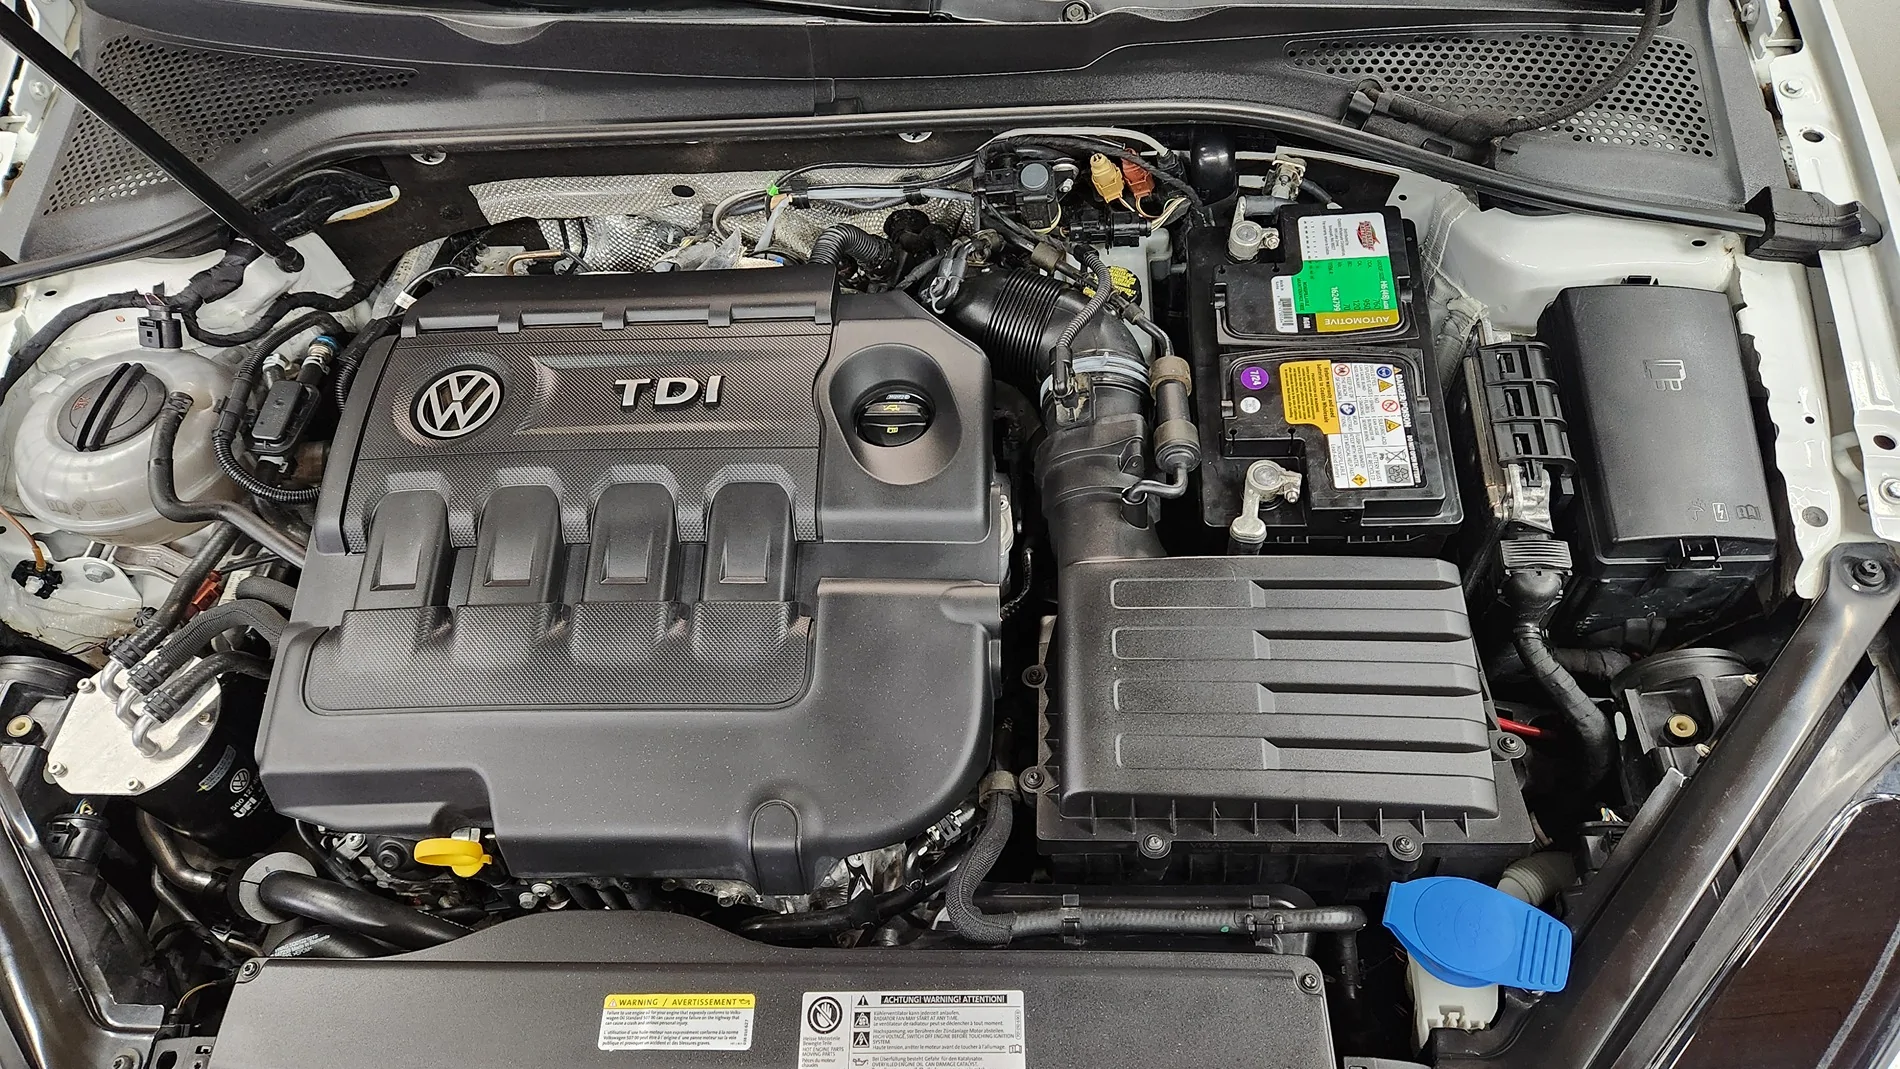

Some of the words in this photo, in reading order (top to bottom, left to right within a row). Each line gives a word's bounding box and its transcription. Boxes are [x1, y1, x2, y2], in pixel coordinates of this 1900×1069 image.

[1330, 286, 1341, 311] 1624799
[1302, 317, 1311, 329] AGM
[1324, 316, 1390, 326] AUTOMOTIVE
[1250, 370, 1262, 386] 7/24
[614, 375, 723, 408] TDI
[1396, 374, 1411, 428] DANGER/POISON
[234, 796, 257, 818] UFI
